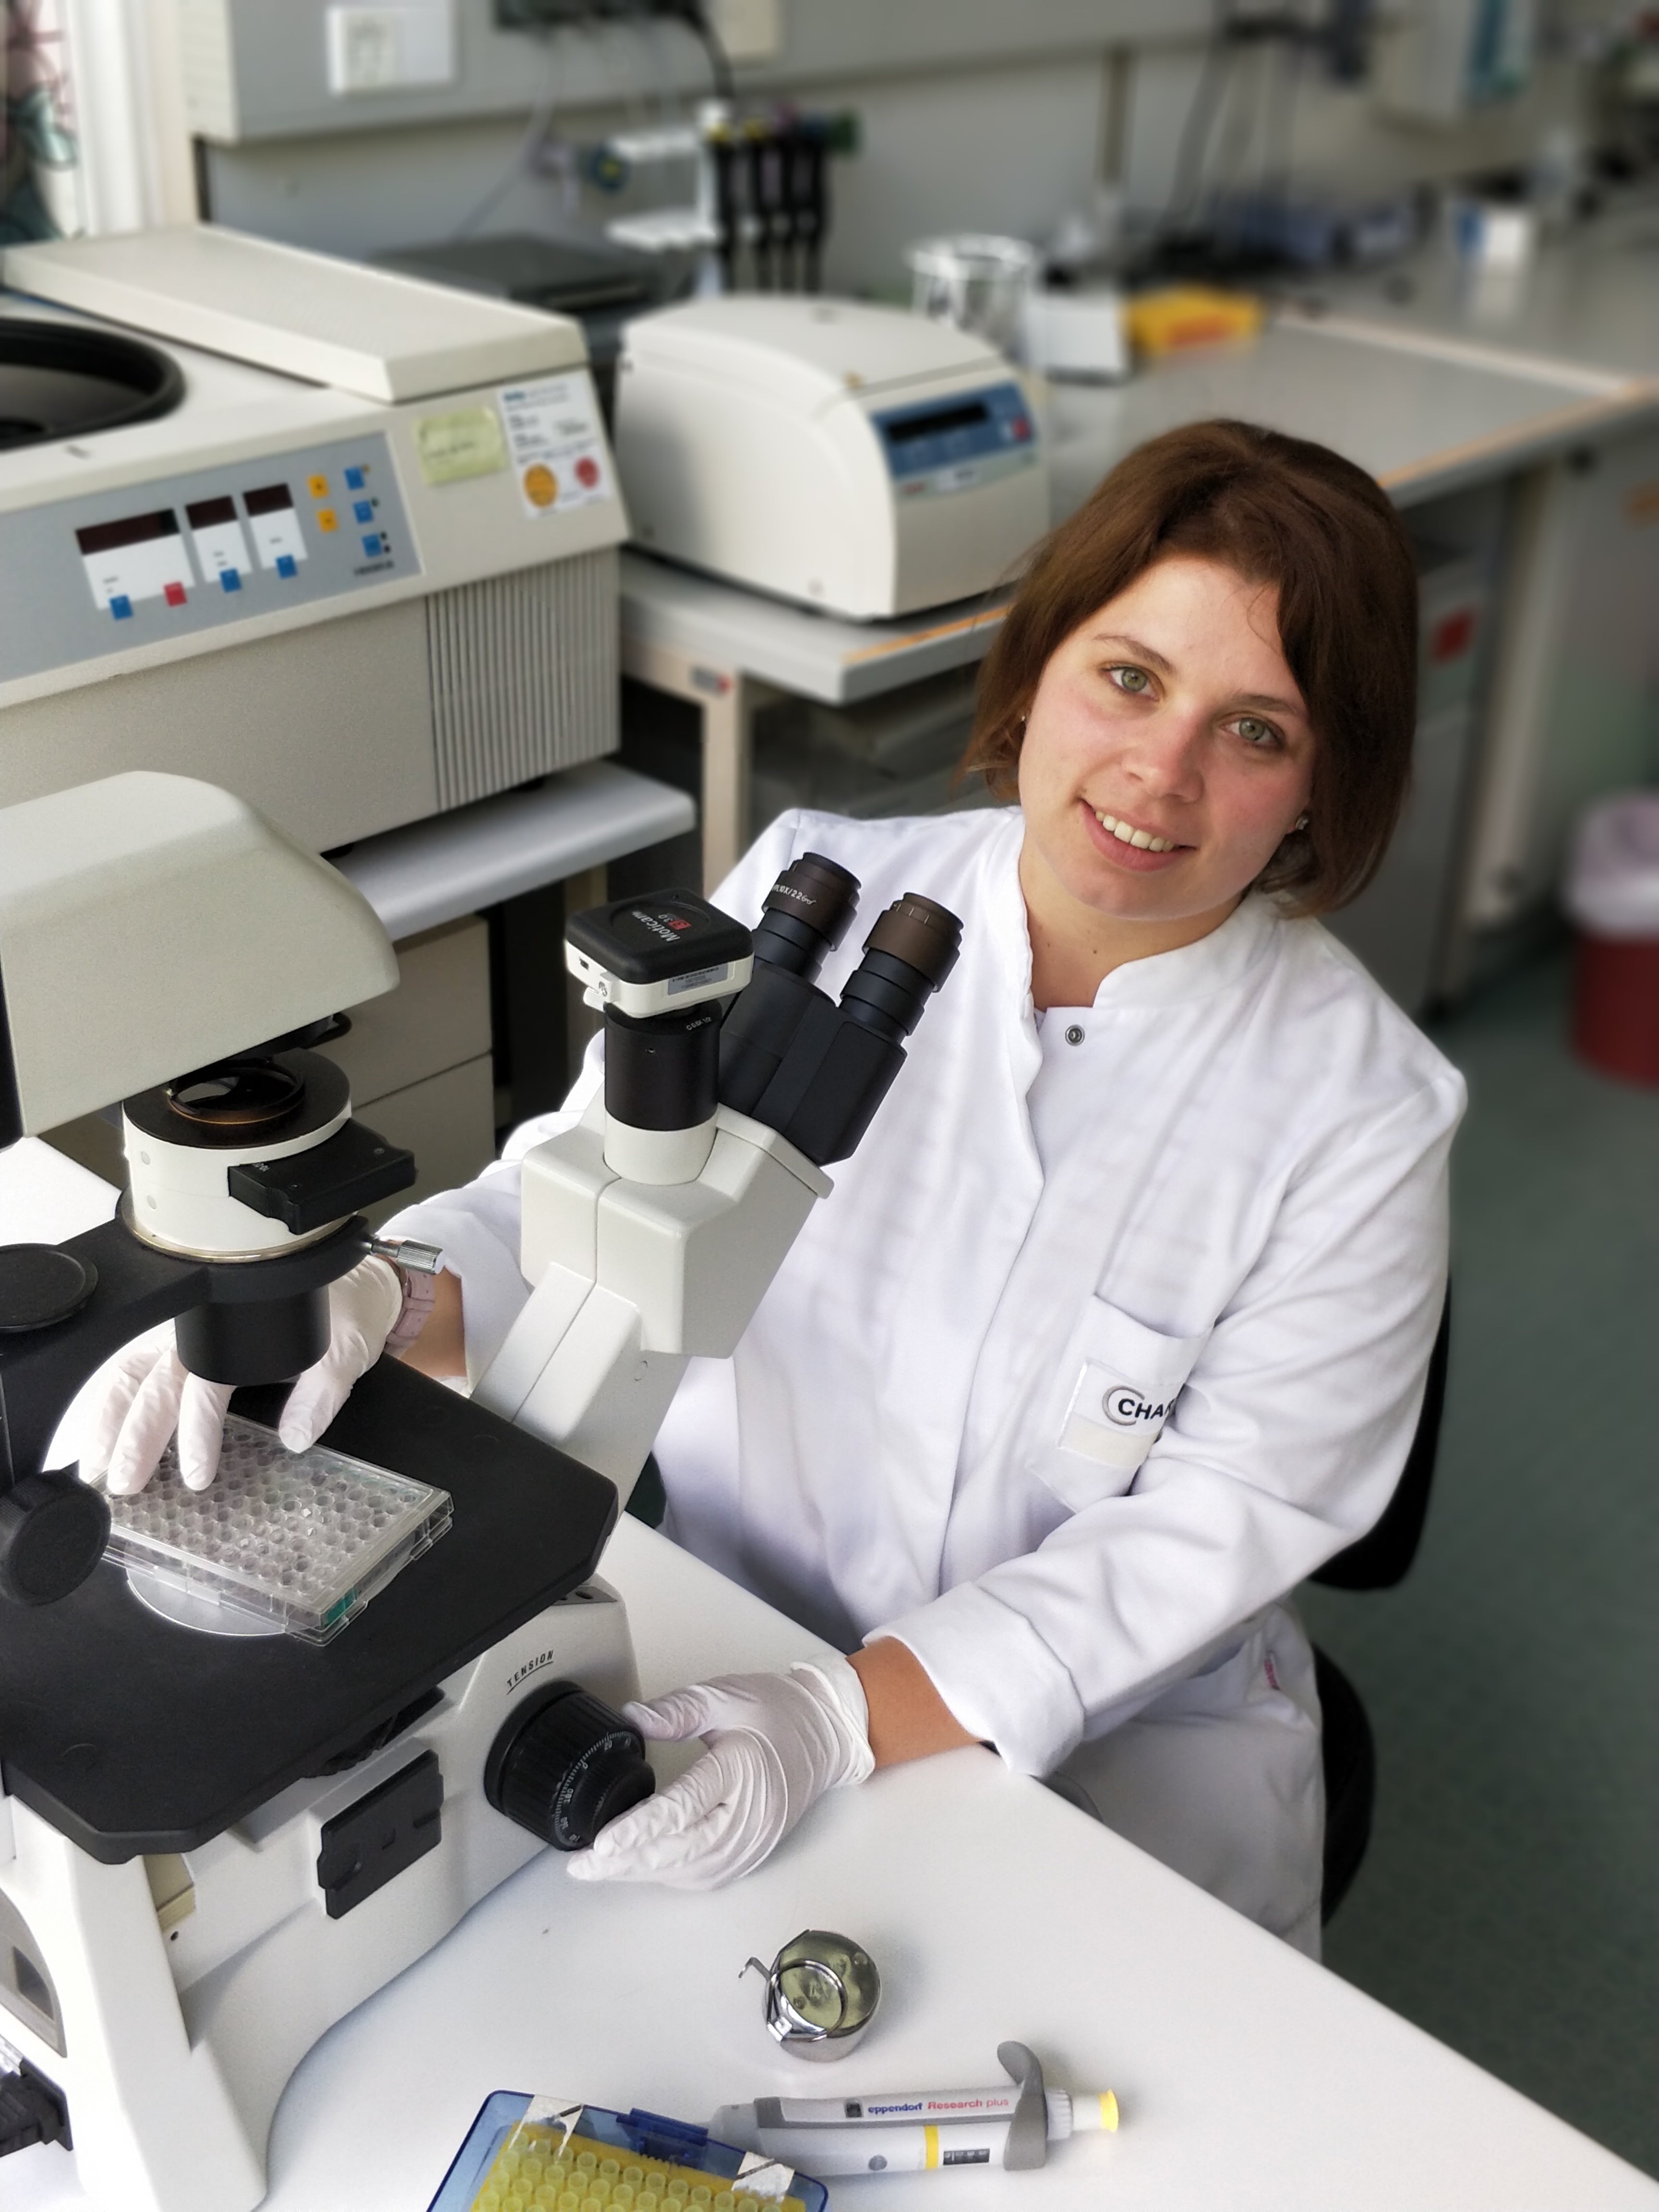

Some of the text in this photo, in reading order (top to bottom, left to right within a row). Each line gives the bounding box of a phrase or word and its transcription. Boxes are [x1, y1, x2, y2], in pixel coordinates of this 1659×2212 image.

[507, 1650, 553, 1687] TENSION
[604, 1740, 613, 1751] 20
[868, 2098, 1009, 2114] eppendorf Research plus
